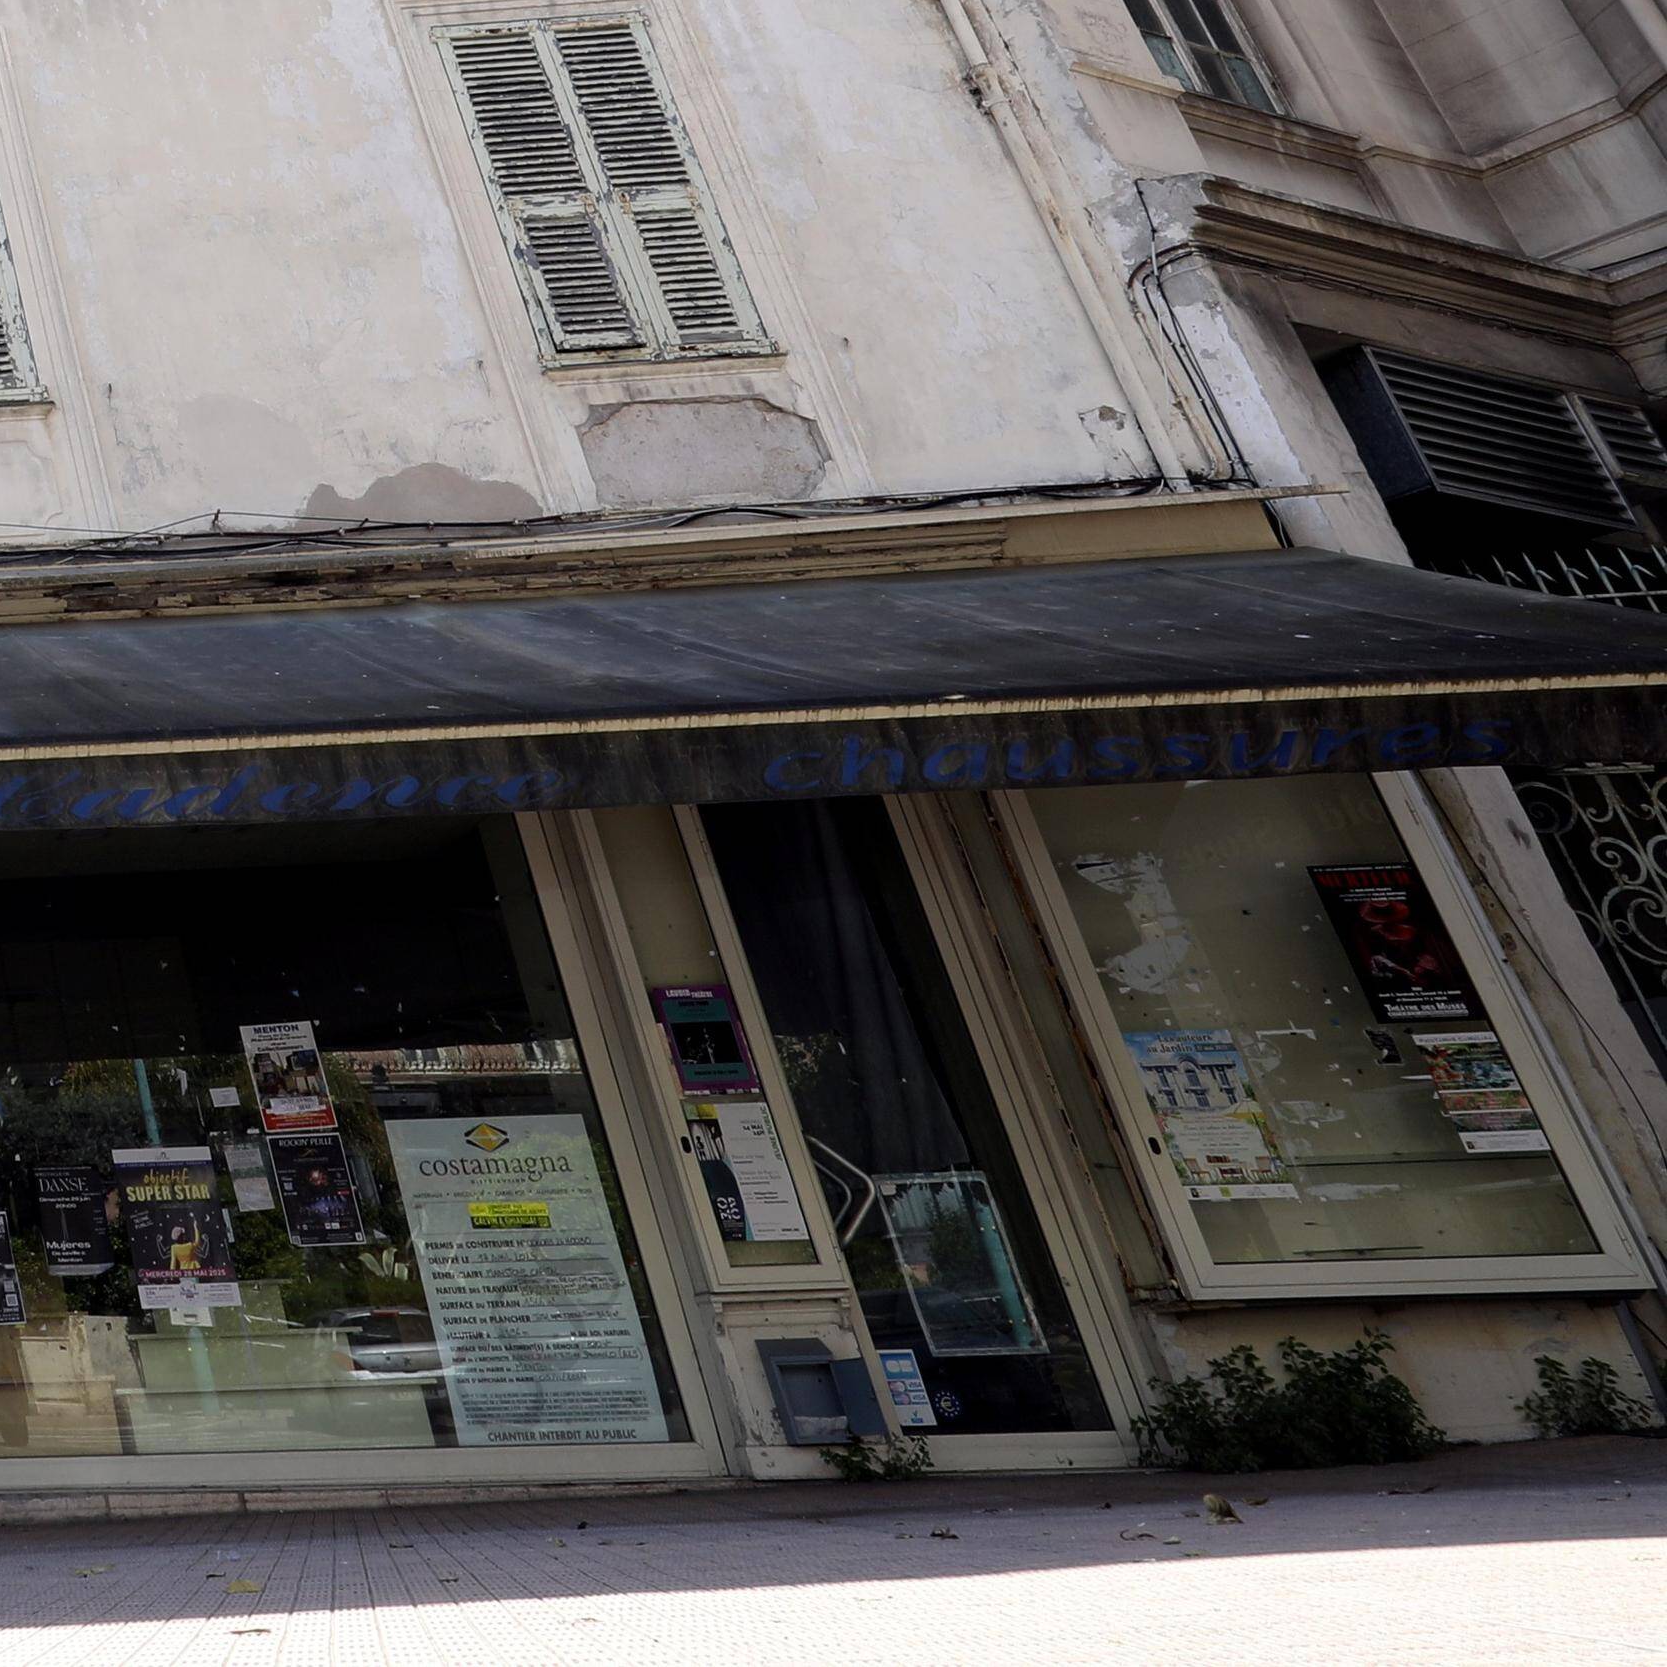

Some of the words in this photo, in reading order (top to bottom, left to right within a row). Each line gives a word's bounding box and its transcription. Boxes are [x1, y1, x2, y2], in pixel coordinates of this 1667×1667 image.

[762, 717, 1513, 791] chaussures
[252, 1024, 300, 1034] MENTON
[1159, 1043, 1193, 1054] Jardin
[418, 1154, 574, 1183] costamagna
[143, 1167, 190, 1185] objectif
[38, 1177, 89, 1192] DANSE
[125, 1185, 172, 1202] SUPER
[173, 1184, 211, 1201] STAR
[46, 1240, 92, 1251] Mujeres
[424, 1241, 454, 1250] PERMIS
[465, 1239, 516, 1249] CONSTRUIRE
[460, 1256, 470, 1264] LE
[144, 1270, 182, 1279] MERCREDI
[193, 1269, 208, 1277] MAI
[209, 1268, 227, 1277] 2025
[435, 1286, 467, 1295] NATURE
[481, 1284, 519, 1294] TRAVAUX
[439, 1301, 474, 1310] SURFACE
[486, 1300, 521, 1309] TERRAIN
[442, 1316, 478, 1326] SURFACE
[489, 1314, 532, 1324] PLANCHER
[487, 1431, 537, 1442] CHANTIER
[537, 1430, 582, 1440] INTERDIT
[586, 1429, 599, 1439] AU
[602, 1428, 638, 1440] PUBLIC
